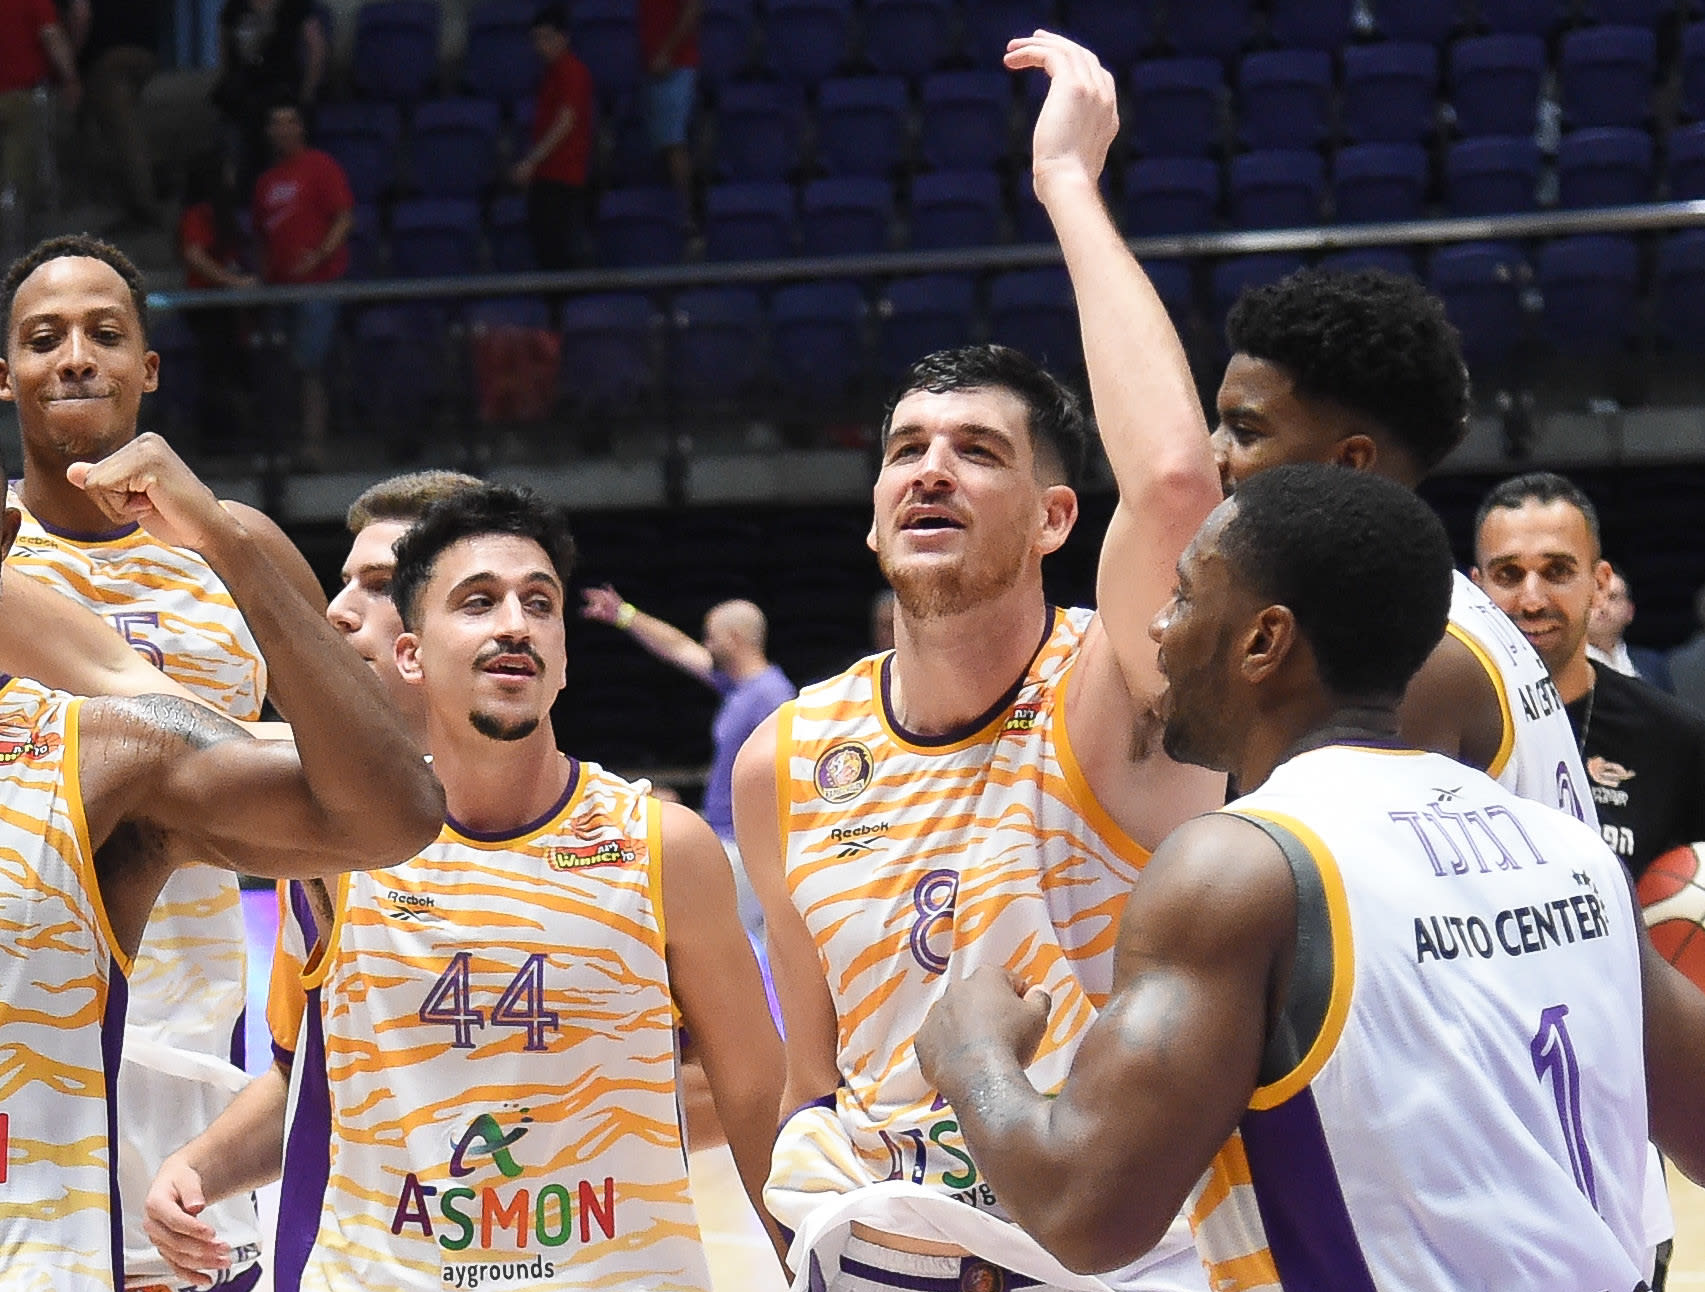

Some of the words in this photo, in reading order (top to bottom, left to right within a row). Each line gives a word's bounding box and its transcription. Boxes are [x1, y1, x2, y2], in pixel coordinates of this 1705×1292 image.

[830, 821, 889, 842] Reebok
[556, 851, 620, 868] Winner
[387, 890, 435, 907] Reebok
[1414, 914, 1494, 964] AUTO
[1495, 893, 1610, 957] CENTER
[418, 952, 560, 1051] 44
[1530, 1003, 1601, 1216] 1
[391, 1172, 616, 1252] ASMON
[442, 1255, 556, 1289] aygrounds
